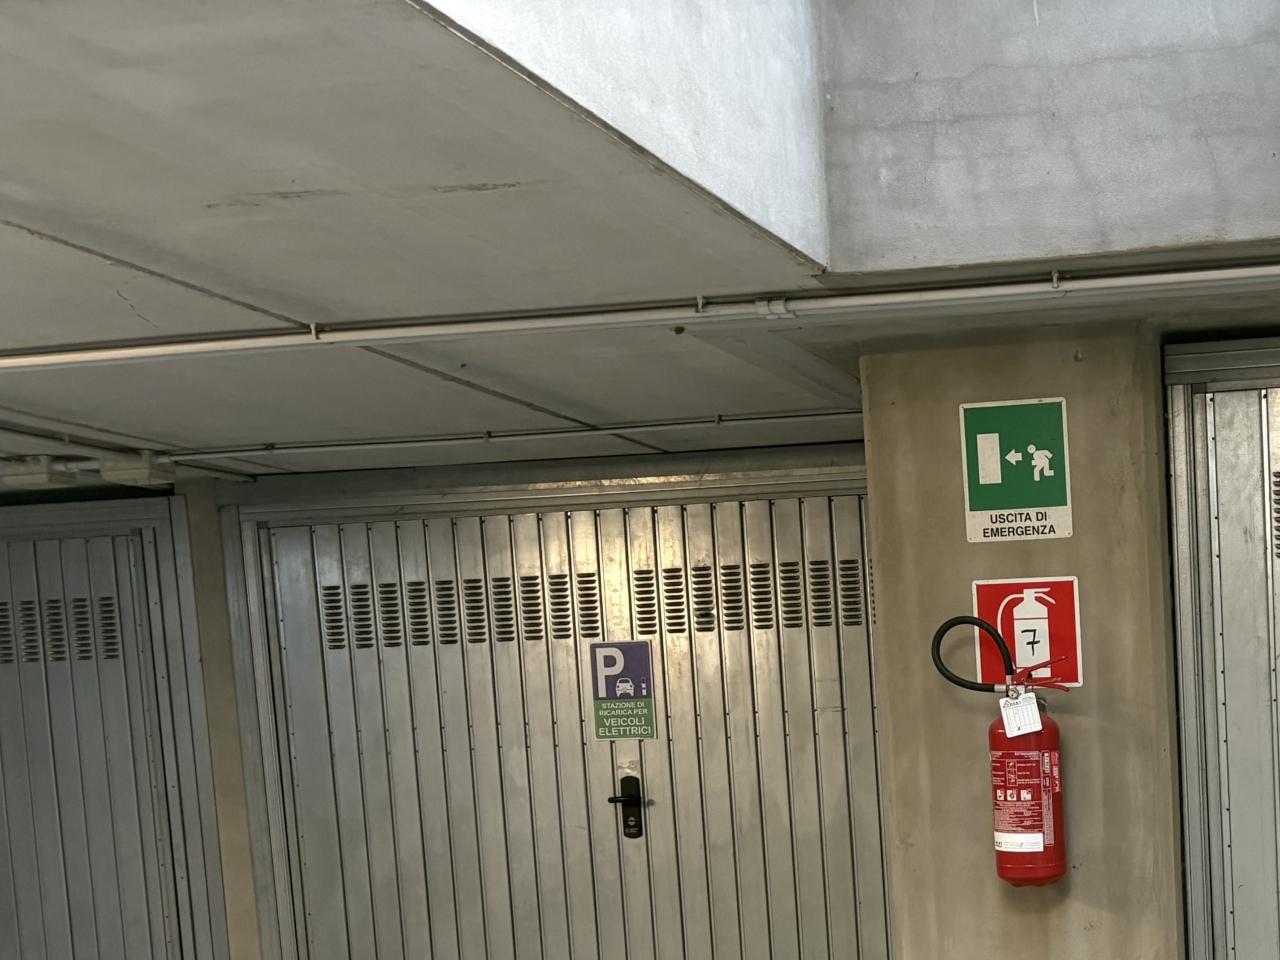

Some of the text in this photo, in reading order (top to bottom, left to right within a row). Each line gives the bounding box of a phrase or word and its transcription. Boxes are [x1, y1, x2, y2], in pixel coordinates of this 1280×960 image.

[990, 511, 1047, 524] USCITA DI
[983, 524, 1056, 537] EMERGENZA
[1020, 628, 1041, 657] 7
[595, 647, 625, 698] P
[603, 717, 645, 726] VEICOLI
[599, 726, 651, 736] ELETTRICI
